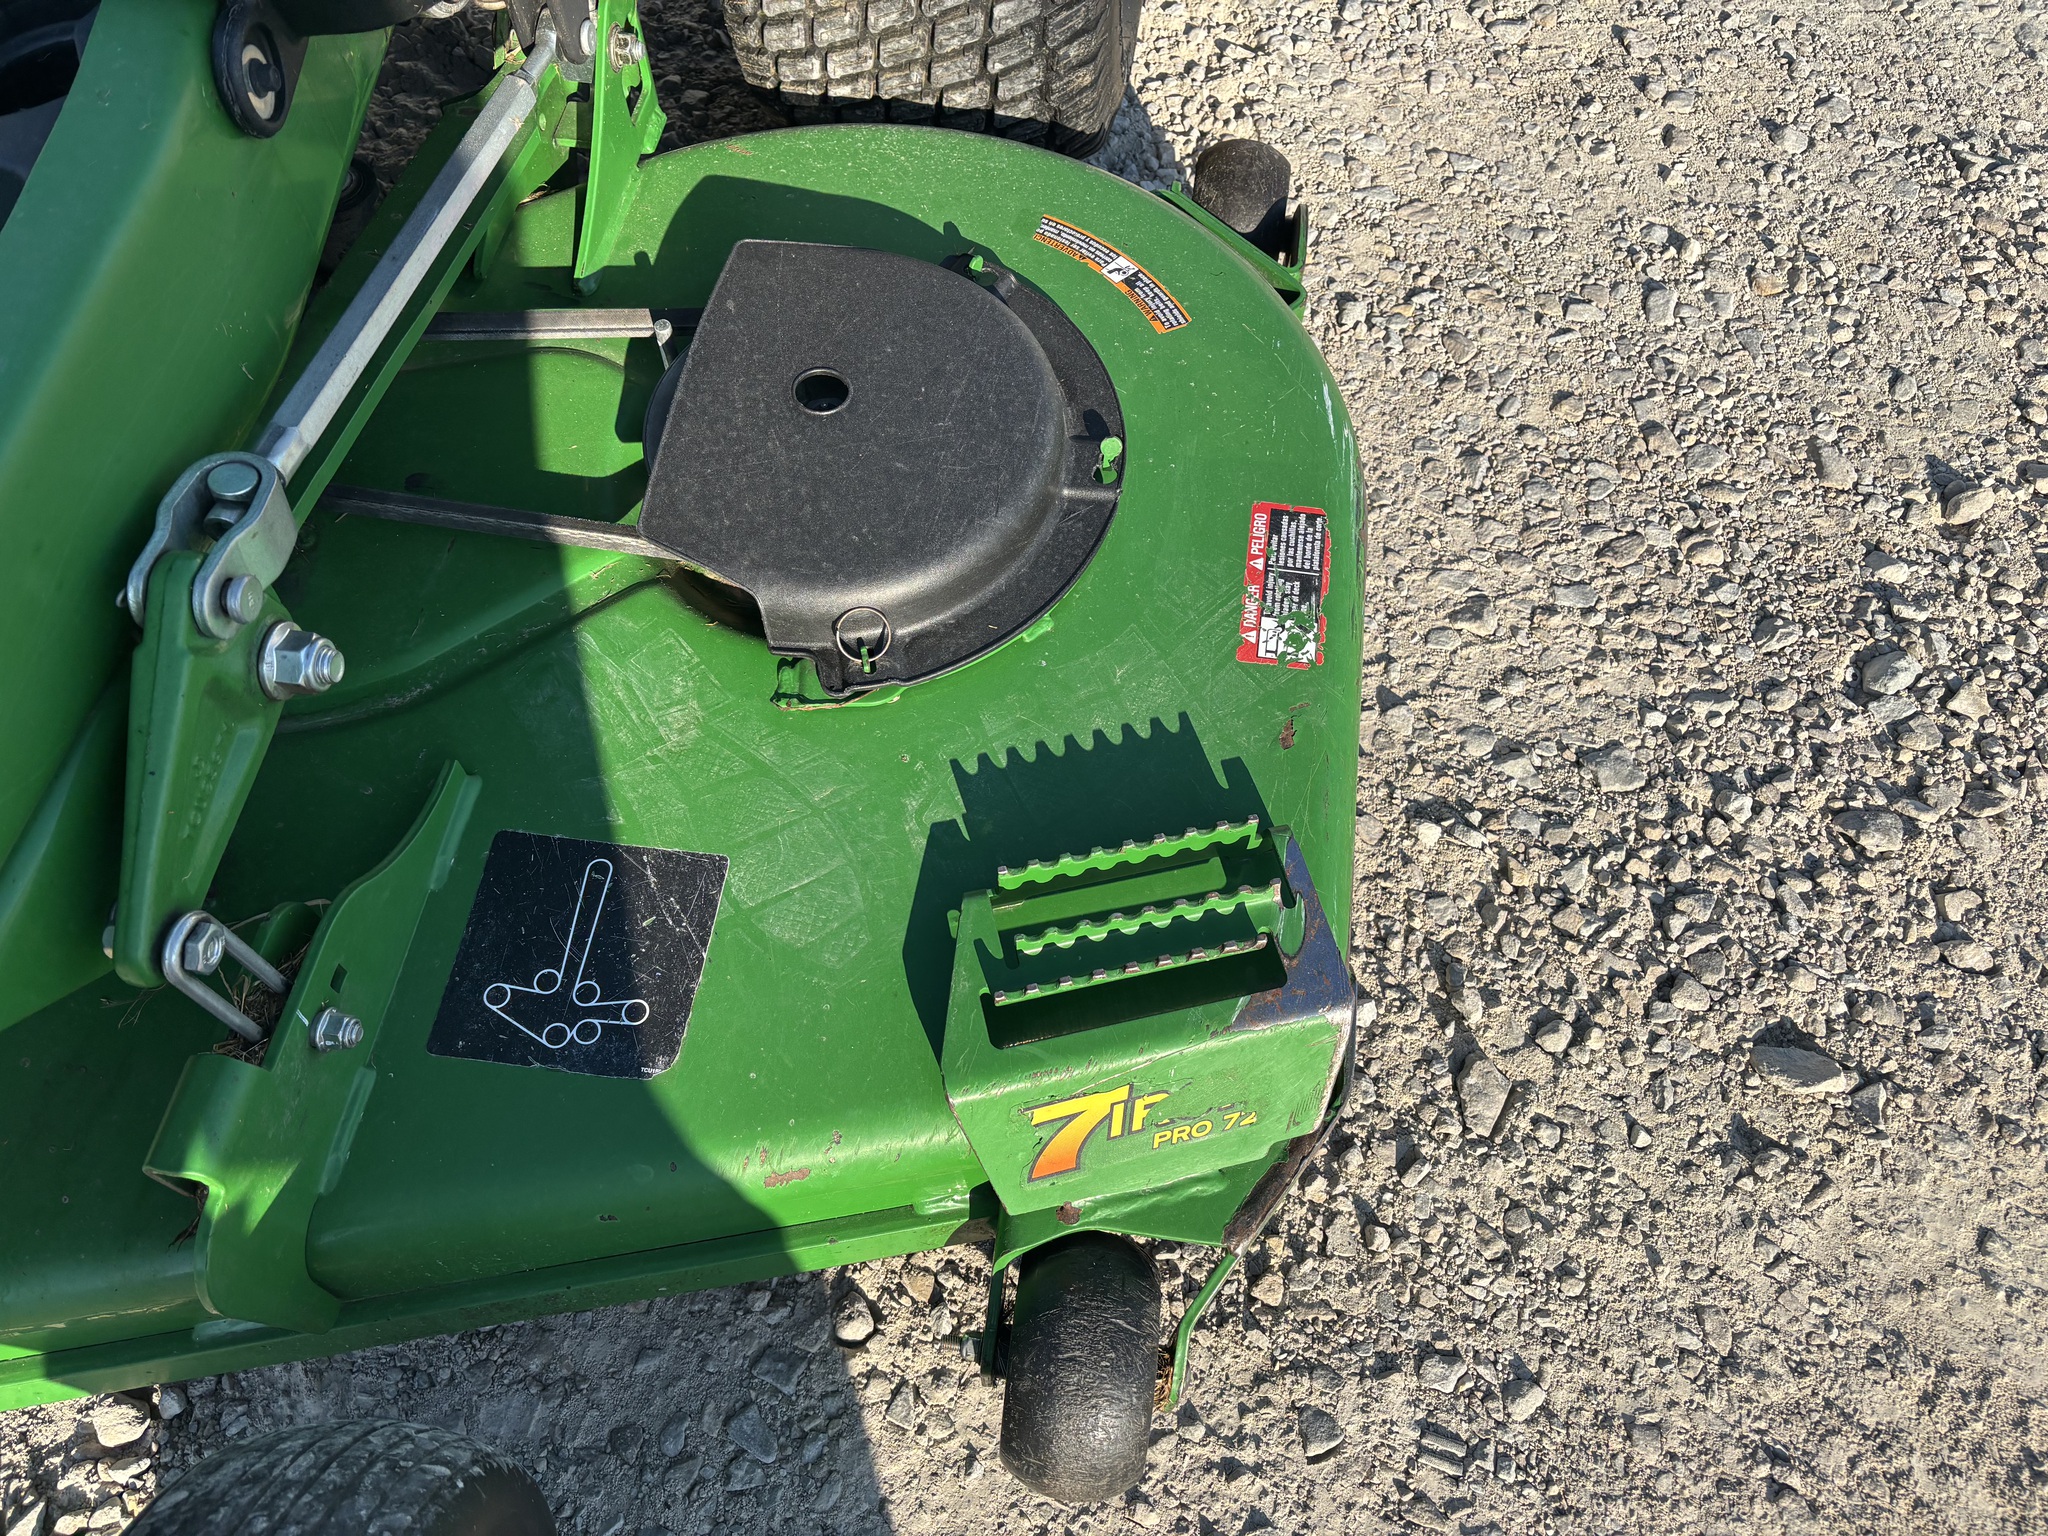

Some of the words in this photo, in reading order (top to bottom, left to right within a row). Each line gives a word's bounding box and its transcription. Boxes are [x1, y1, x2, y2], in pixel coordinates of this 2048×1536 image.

[1034, 234, 1078, 257] ADVERTENCI
[1124, 289, 1152, 316] WARNING
[1251, 513, 1267, 555] PELIGRO
[1280, 515, 1289, 541] causadas
[1288, 520, 1298, 546] cuchillas,
[1297, 513, 1308, 534] alejado
[1305, 534, 1313, 542] de
[1315, 532, 1321, 540] de
[1277, 542, 1286, 566] lesiones
[1295, 535, 1304, 568] mantenerse
[1304, 542, 1312, 559] borde
[1312, 540, 1321, 571] plataforma
[1303, 560, 1311, 569] del
[1266, 572, 1276, 589] injury
[1292, 581, 1301, 595] deck
[1243, 584, 1260, 627] DANGER
[1264, 590, 1273, 606] avoid
[1281, 596, 1291, 614] lades,
[1152, 1119, 1214, 1150] PRO
[1222, 1110, 1258, 1133] 72
